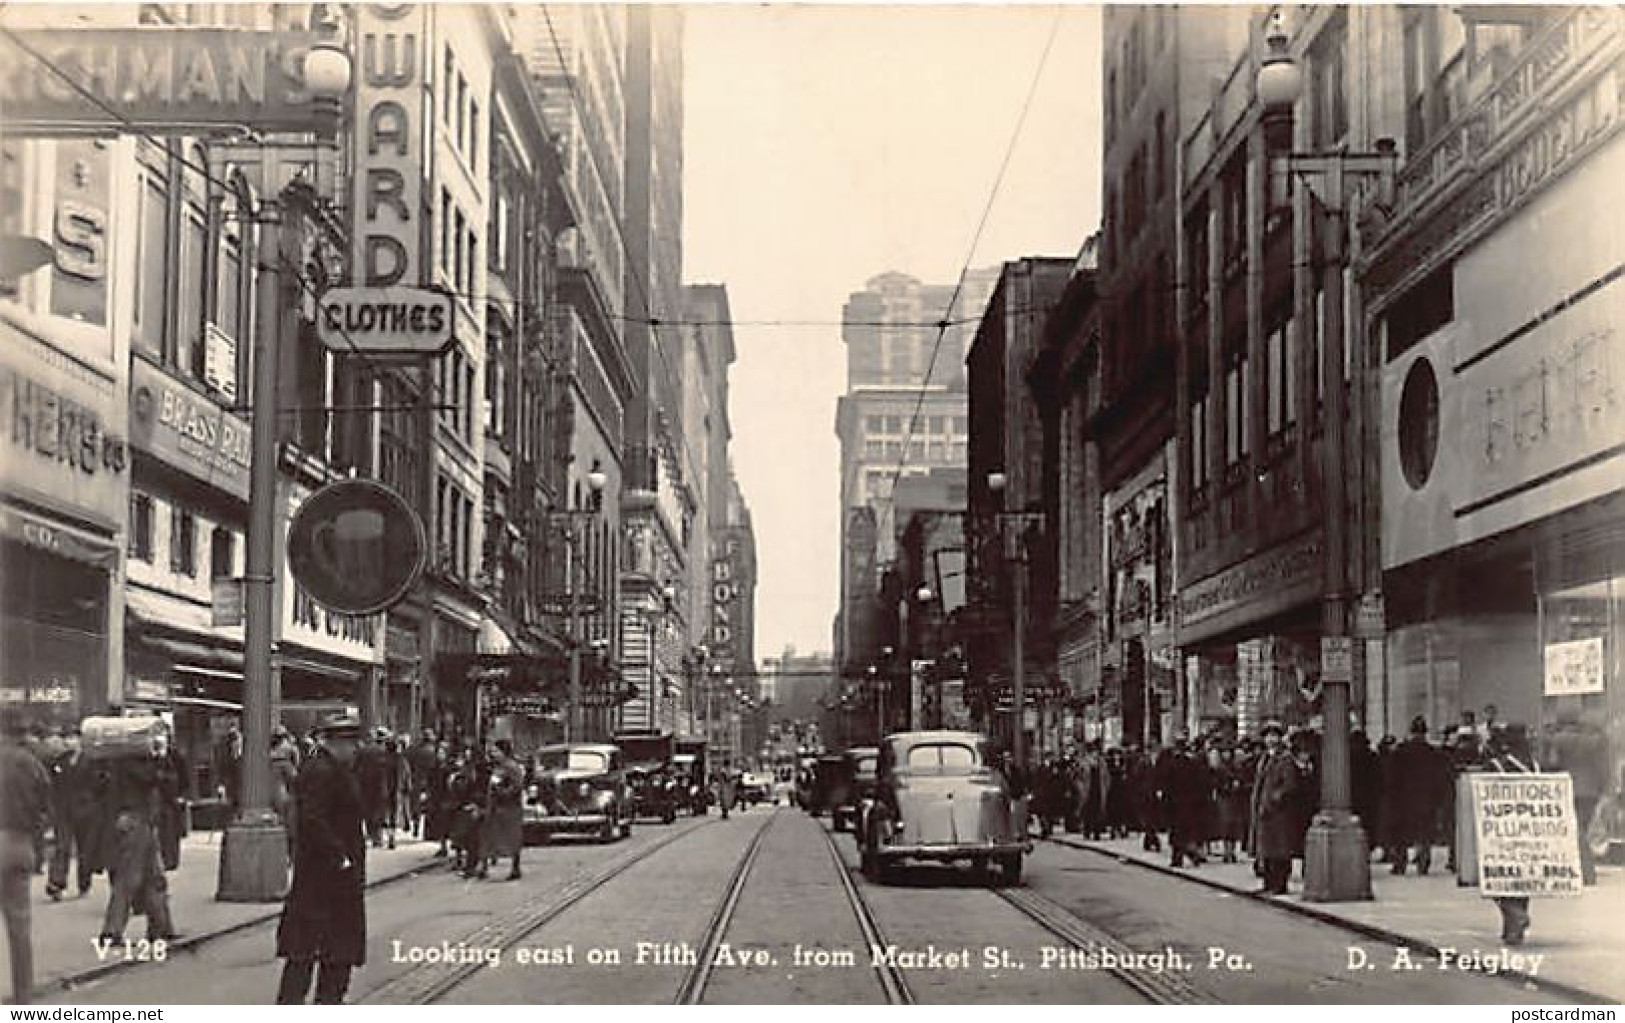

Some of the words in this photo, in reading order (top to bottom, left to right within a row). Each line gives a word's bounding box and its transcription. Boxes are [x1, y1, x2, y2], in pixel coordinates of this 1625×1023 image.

[364, 4, 417, 286] WARD
[324, 303, 445, 333] CLOTHES
[160, 388, 216, 448] BRASS
[1483, 803, 1563, 817] SUPPLIES
